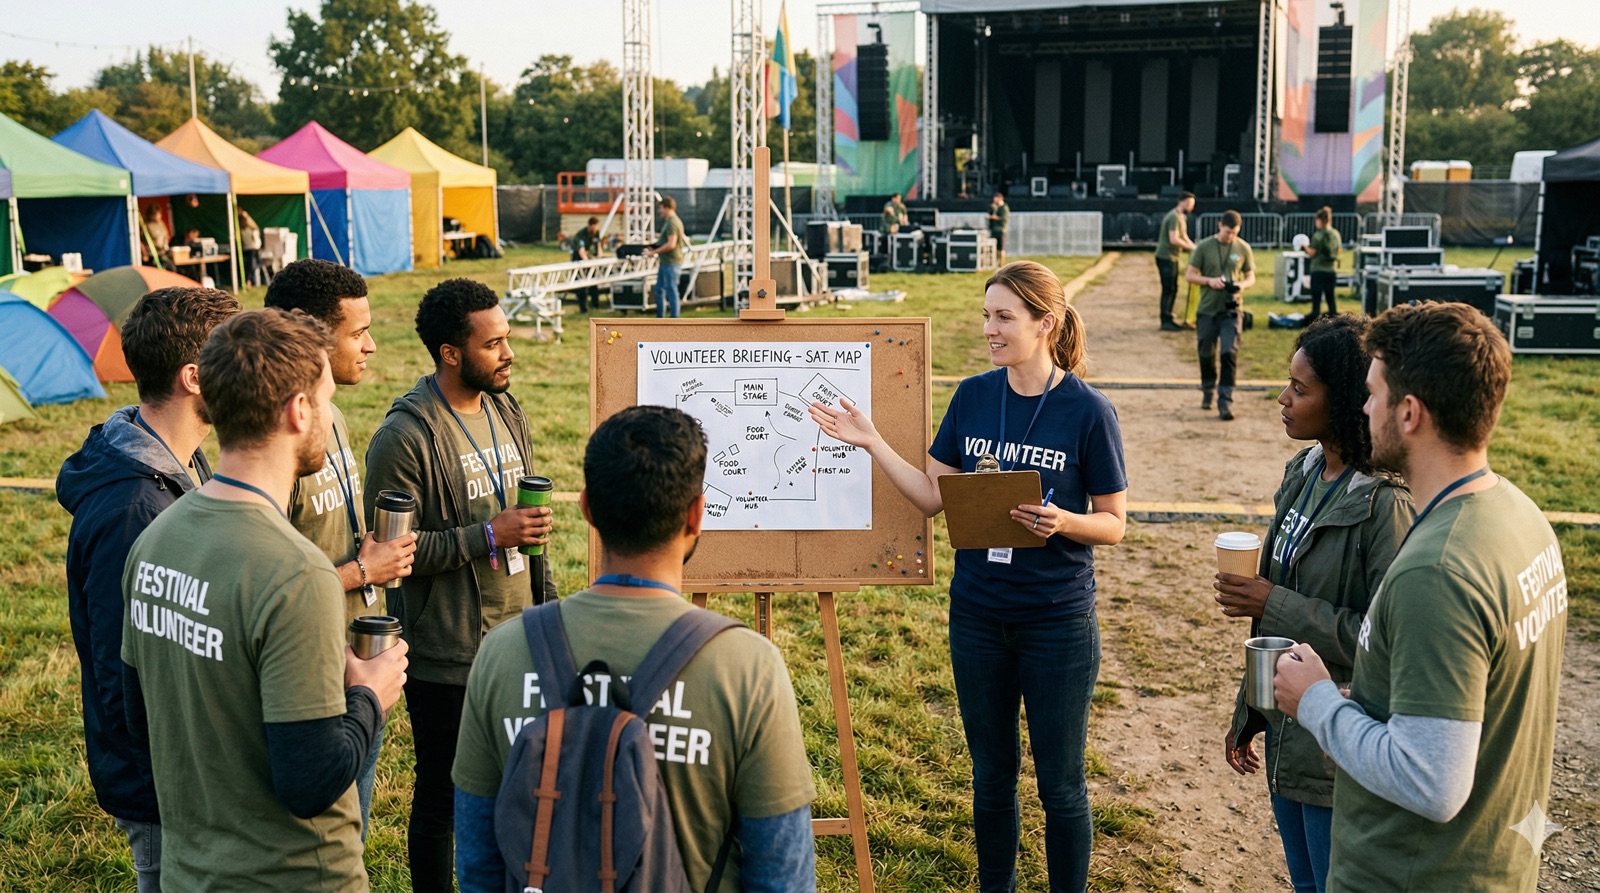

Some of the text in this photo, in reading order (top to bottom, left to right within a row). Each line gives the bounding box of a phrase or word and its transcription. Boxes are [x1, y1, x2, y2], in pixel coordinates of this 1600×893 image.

[650, 349, 726, 364] VOLUNTEER
[733, 349, 792, 364] BRIEFING
[805, 349, 830, 363] SAT.
[834, 350, 862, 364] MAP
[743, 383, 764, 391] MAIN
[743, 392, 768, 400] STAGE
[719, 460, 739, 468] FOOD
[722, 468, 747, 476] COURT
[135, 560, 210, 616] FESTIVAL
